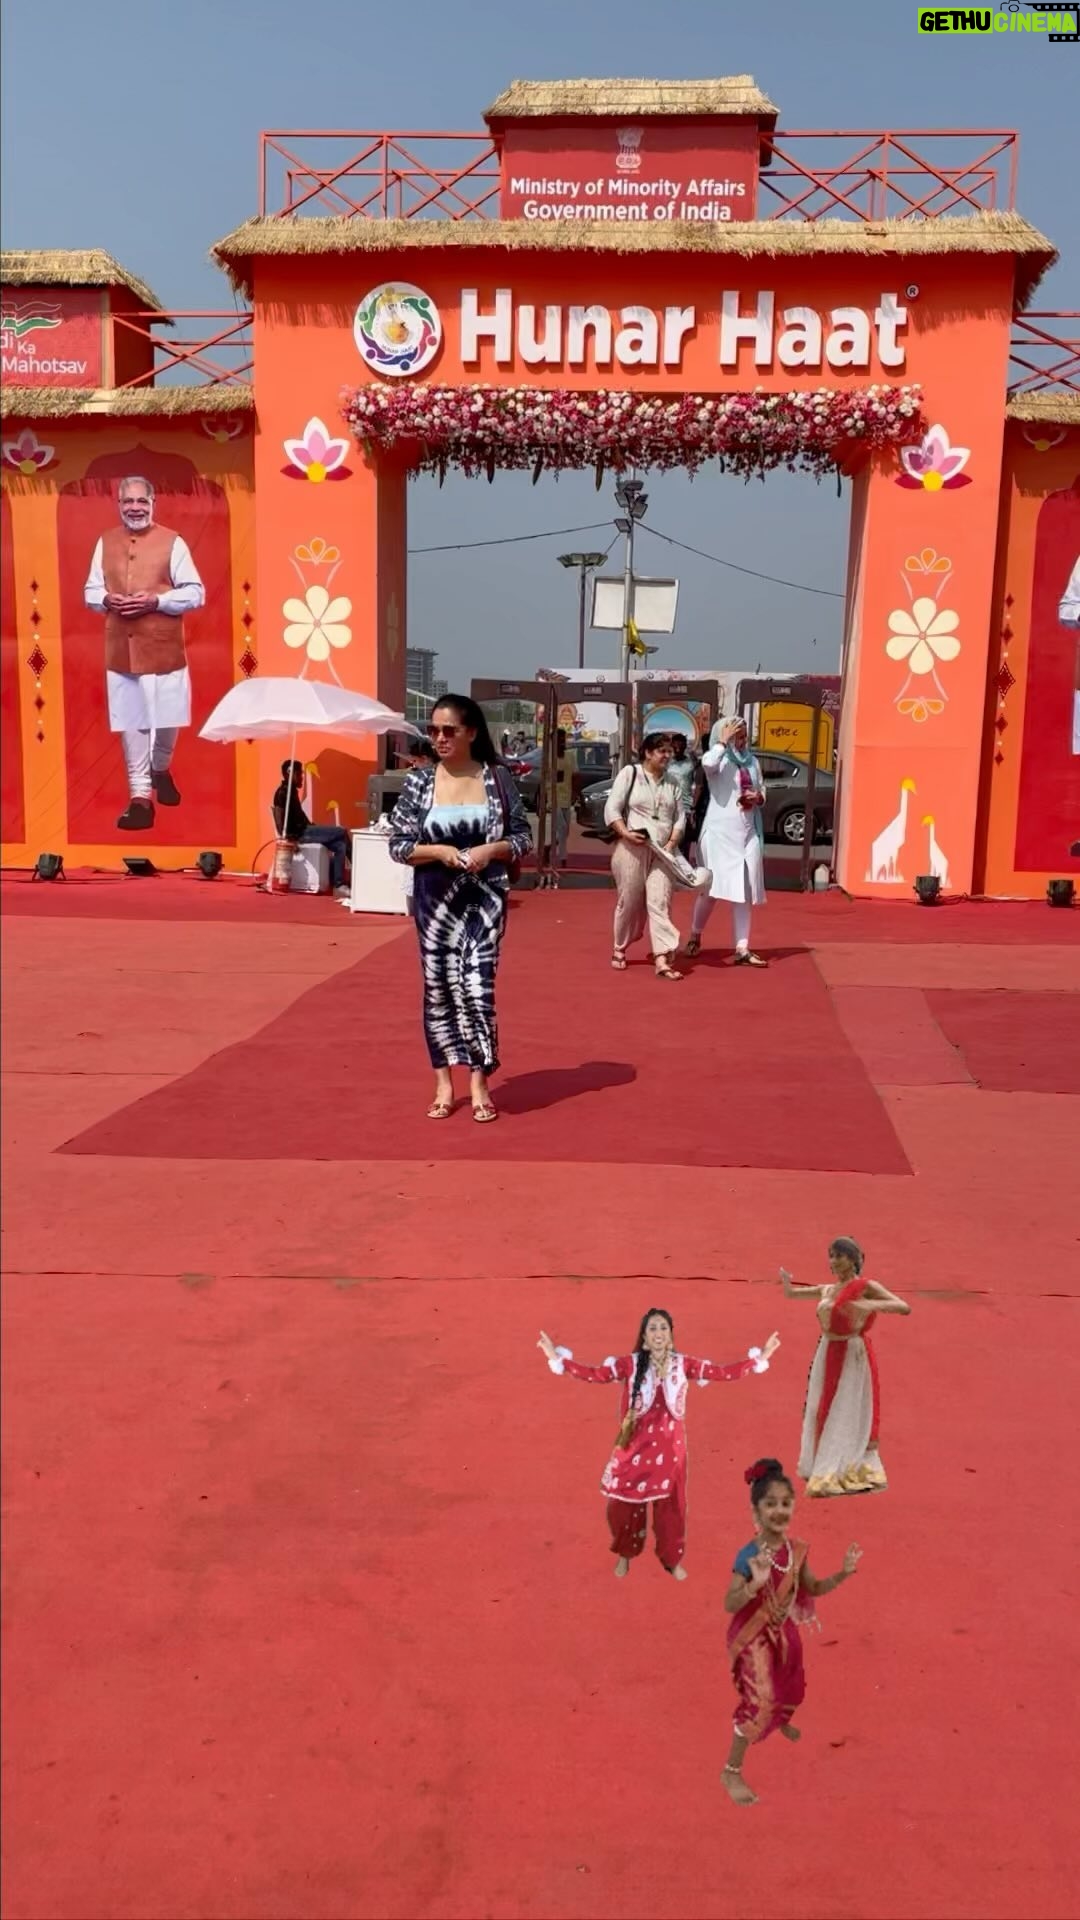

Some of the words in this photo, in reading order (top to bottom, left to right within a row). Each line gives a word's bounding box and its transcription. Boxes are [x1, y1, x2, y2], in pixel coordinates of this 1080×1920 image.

[510, 178, 578, 198] Ministry
[585, 179, 604, 196] of
[608, 178, 681, 198] Minority
[686, 179, 746, 197] Affairs
[523, 200, 648, 220] Government
[653, 200, 675, 220] of
[680, 201, 731, 220] India
[460, 287, 695, 365] Hunar
[719, 289, 907, 367] Haat
[17, 341, 36, 355] Ka
[2, 356, 87, 374] Mahotsav
